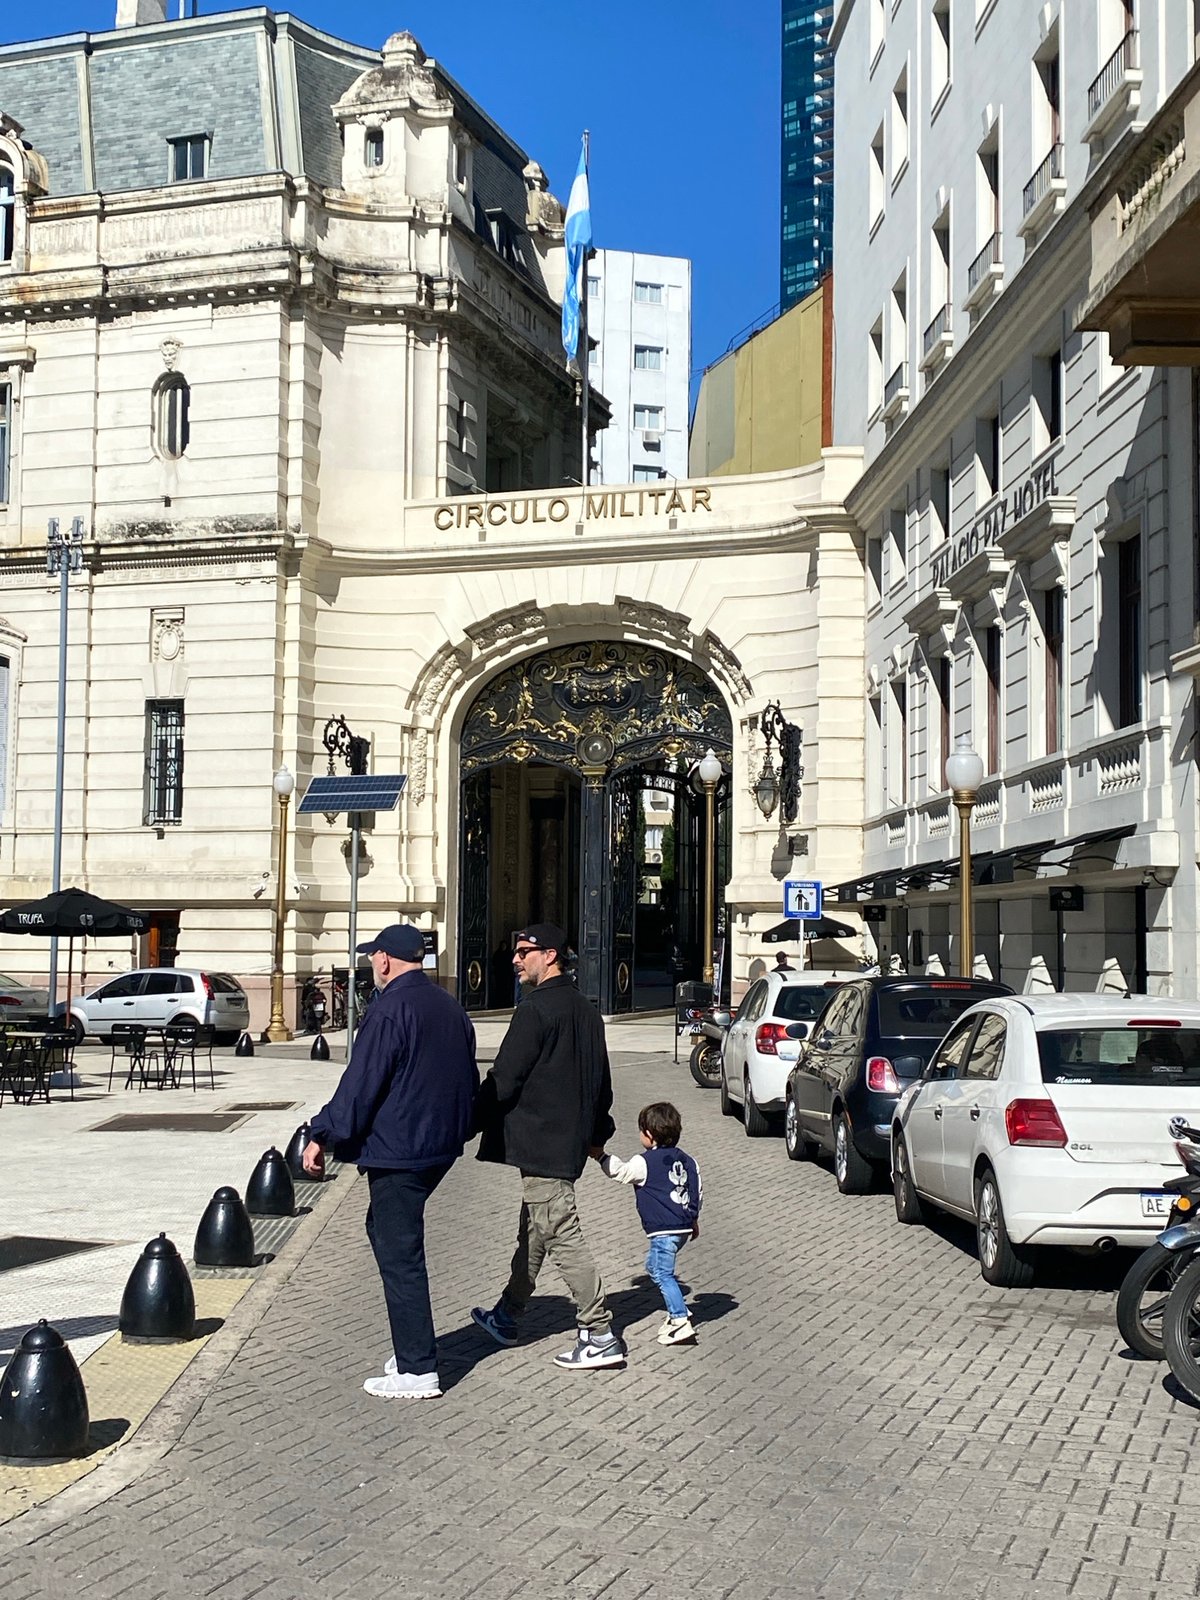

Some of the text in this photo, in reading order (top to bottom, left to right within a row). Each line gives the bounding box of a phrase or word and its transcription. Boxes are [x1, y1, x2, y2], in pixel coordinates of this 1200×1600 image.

[434, 486, 712, 530] CIRCULO MILITAR
[932, 457, 1059, 589] PALACIO PAZ HOTEL
[18, 913, 45, 925] TRUFA
[1071, 1143, 1093, 1151] GOL
[1147, 1198, 1165, 1212] AE
